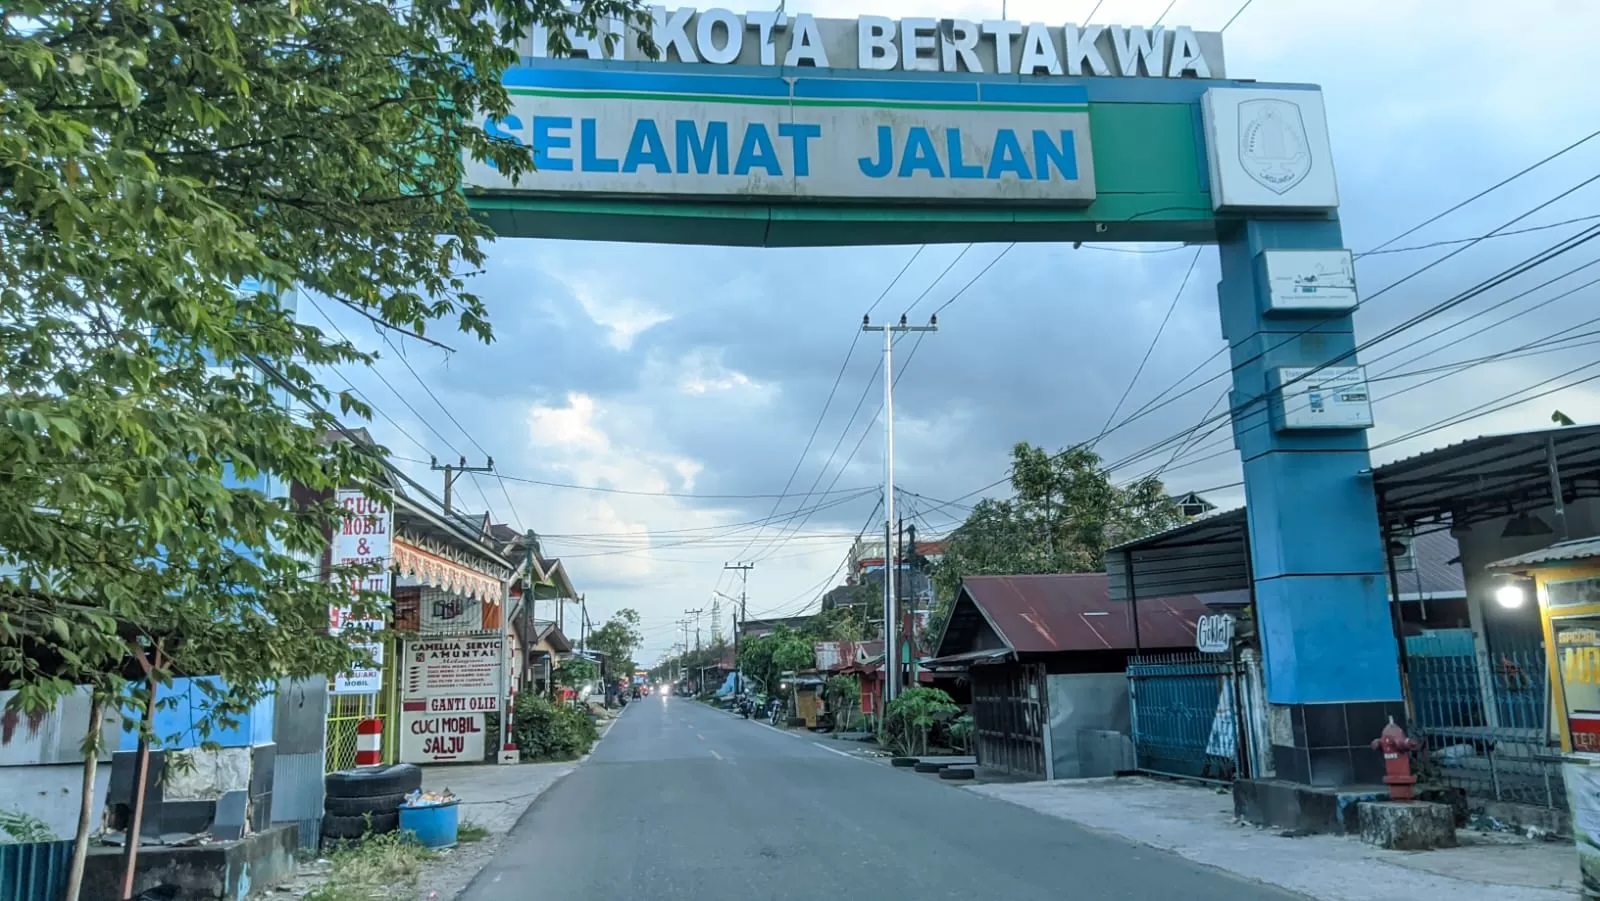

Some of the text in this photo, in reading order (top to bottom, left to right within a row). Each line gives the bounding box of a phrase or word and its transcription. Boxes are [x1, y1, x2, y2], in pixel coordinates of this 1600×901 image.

[651, 5, 829, 68] KOTA
[858, 15, 1212, 78] BERTAKWA
[483, 114, 1079, 181] SELAMAT JALAN
[343, 517, 385, 535] MOBIL
[357, 538, 370, 555] &
[411, 642, 461, 651] CAMELLIA
[430, 650, 495, 658] AMUNTAI
[431, 697, 496, 711] GANTI OLIE
[411, 716, 481, 735] CUCI MOBIL
[423, 736, 464, 753] SALJU
